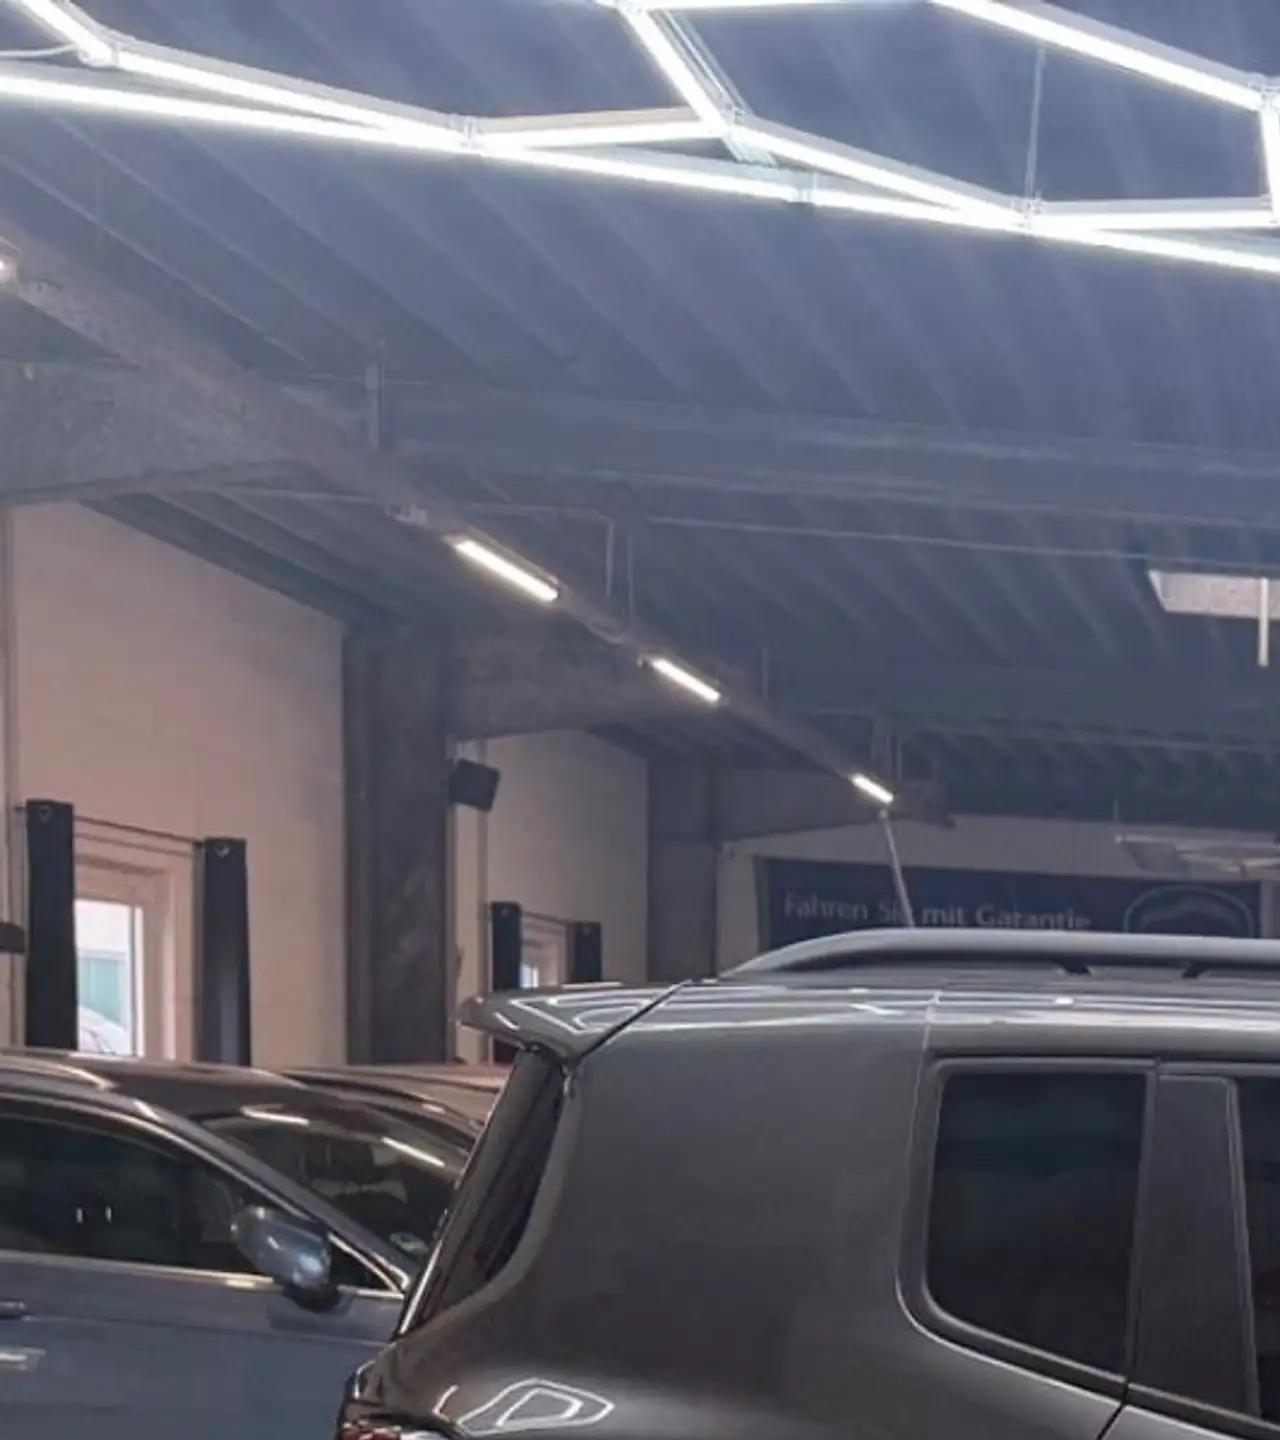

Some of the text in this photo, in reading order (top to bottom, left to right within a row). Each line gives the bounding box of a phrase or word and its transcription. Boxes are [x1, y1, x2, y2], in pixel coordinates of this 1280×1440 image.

[783, 893, 1092, 929] Fahren Si mit Garantie
